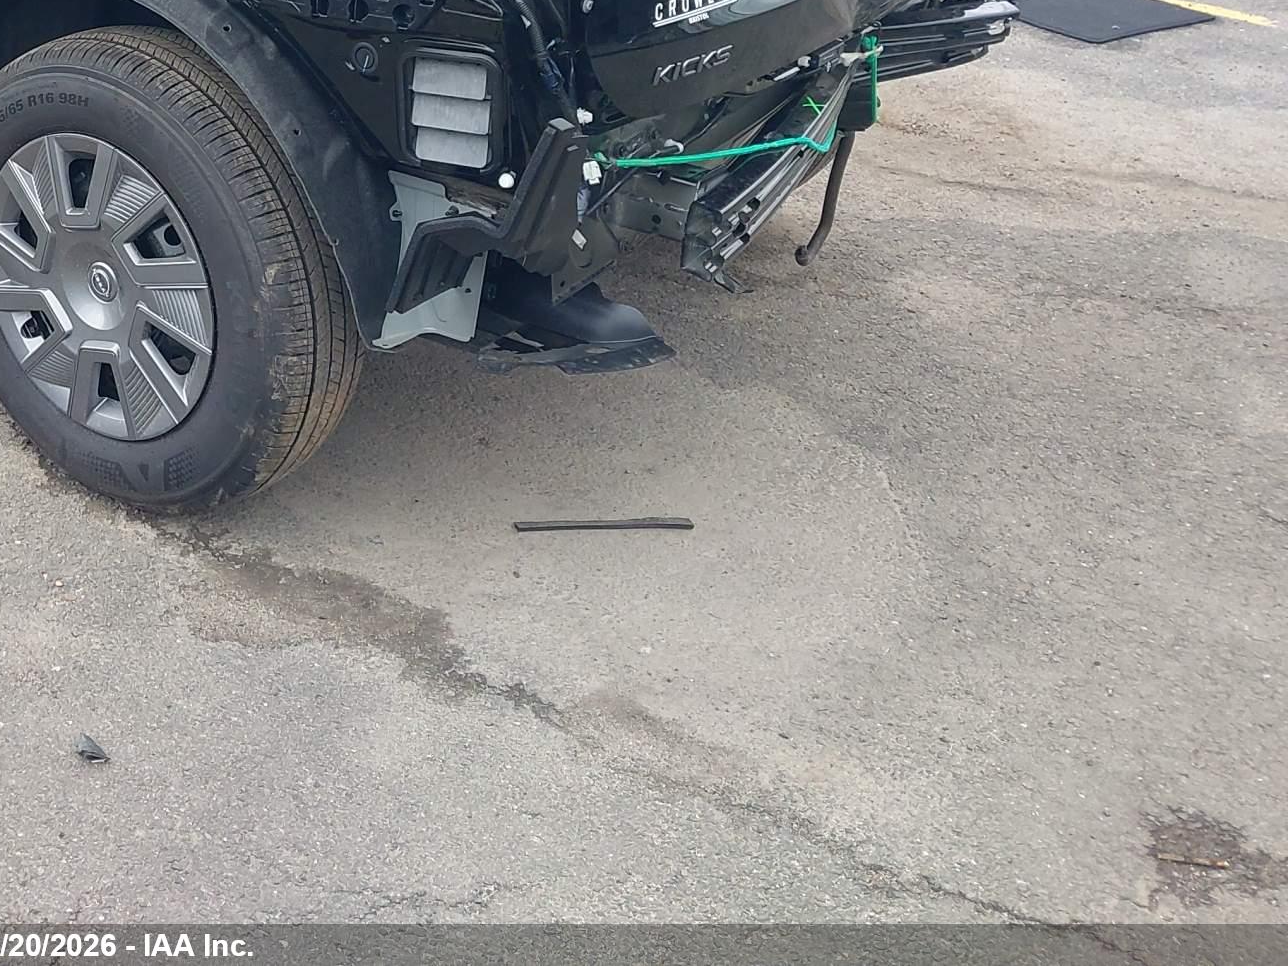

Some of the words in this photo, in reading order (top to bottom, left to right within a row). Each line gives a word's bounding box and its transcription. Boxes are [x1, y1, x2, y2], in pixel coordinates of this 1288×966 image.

[651, 44, 734, 87] KICKS
[28, 92, 54, 108] R16
[58, 92, 90, 107] 98H
